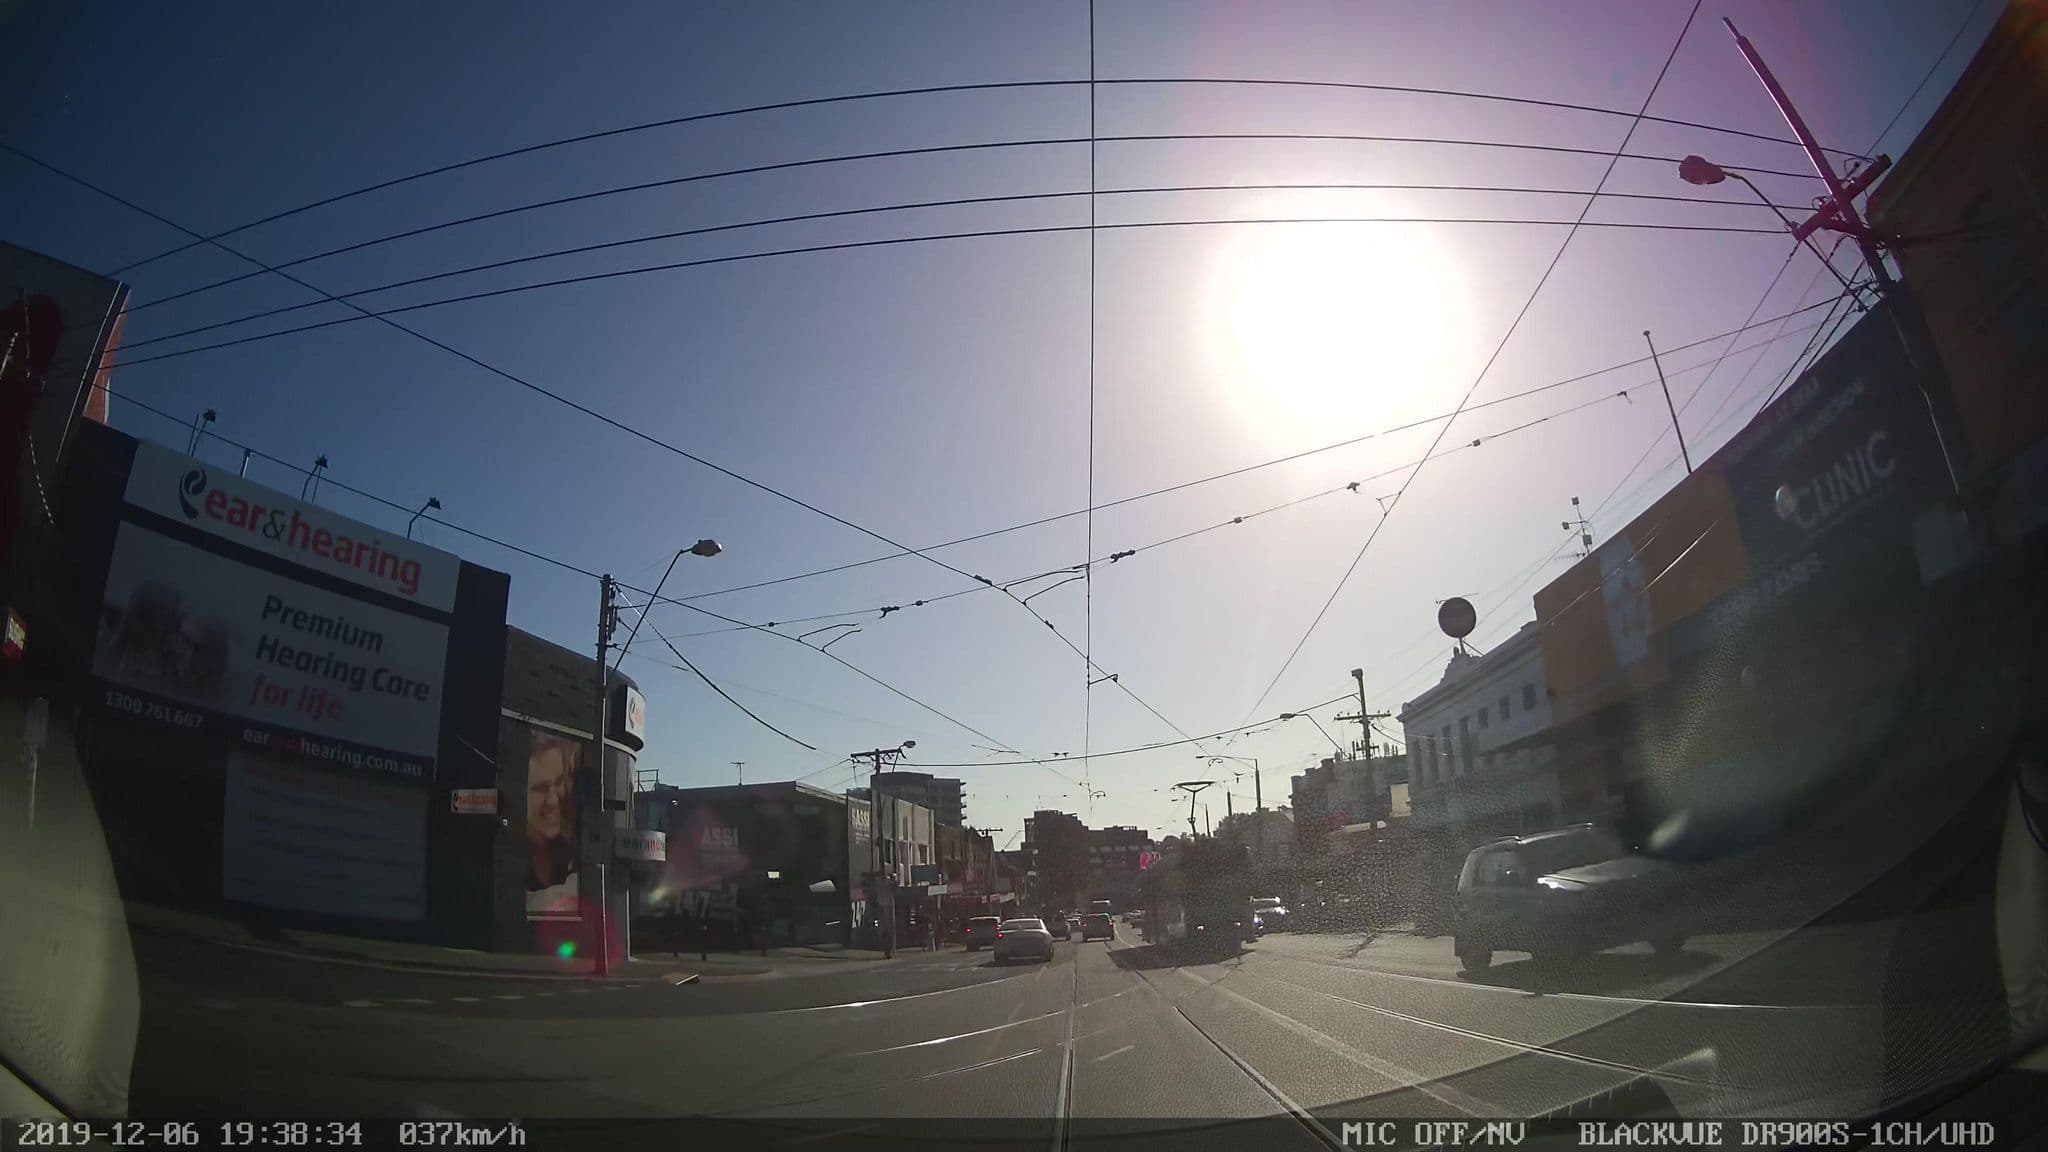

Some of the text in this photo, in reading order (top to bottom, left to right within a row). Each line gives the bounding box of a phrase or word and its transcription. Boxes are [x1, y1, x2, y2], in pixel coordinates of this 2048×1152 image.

[1791, 431, 1897, 529] CLINIC
[205, 486, 422, 596] ear&hearing
[262, 594, 384, 654] Premium
[249, 673, 345, 721] for life
[255, 633, 431, 702] Hearing Care
[105, 689, 144, 715] 1300
[243, 726, 423, 777] earhearing.com.au
